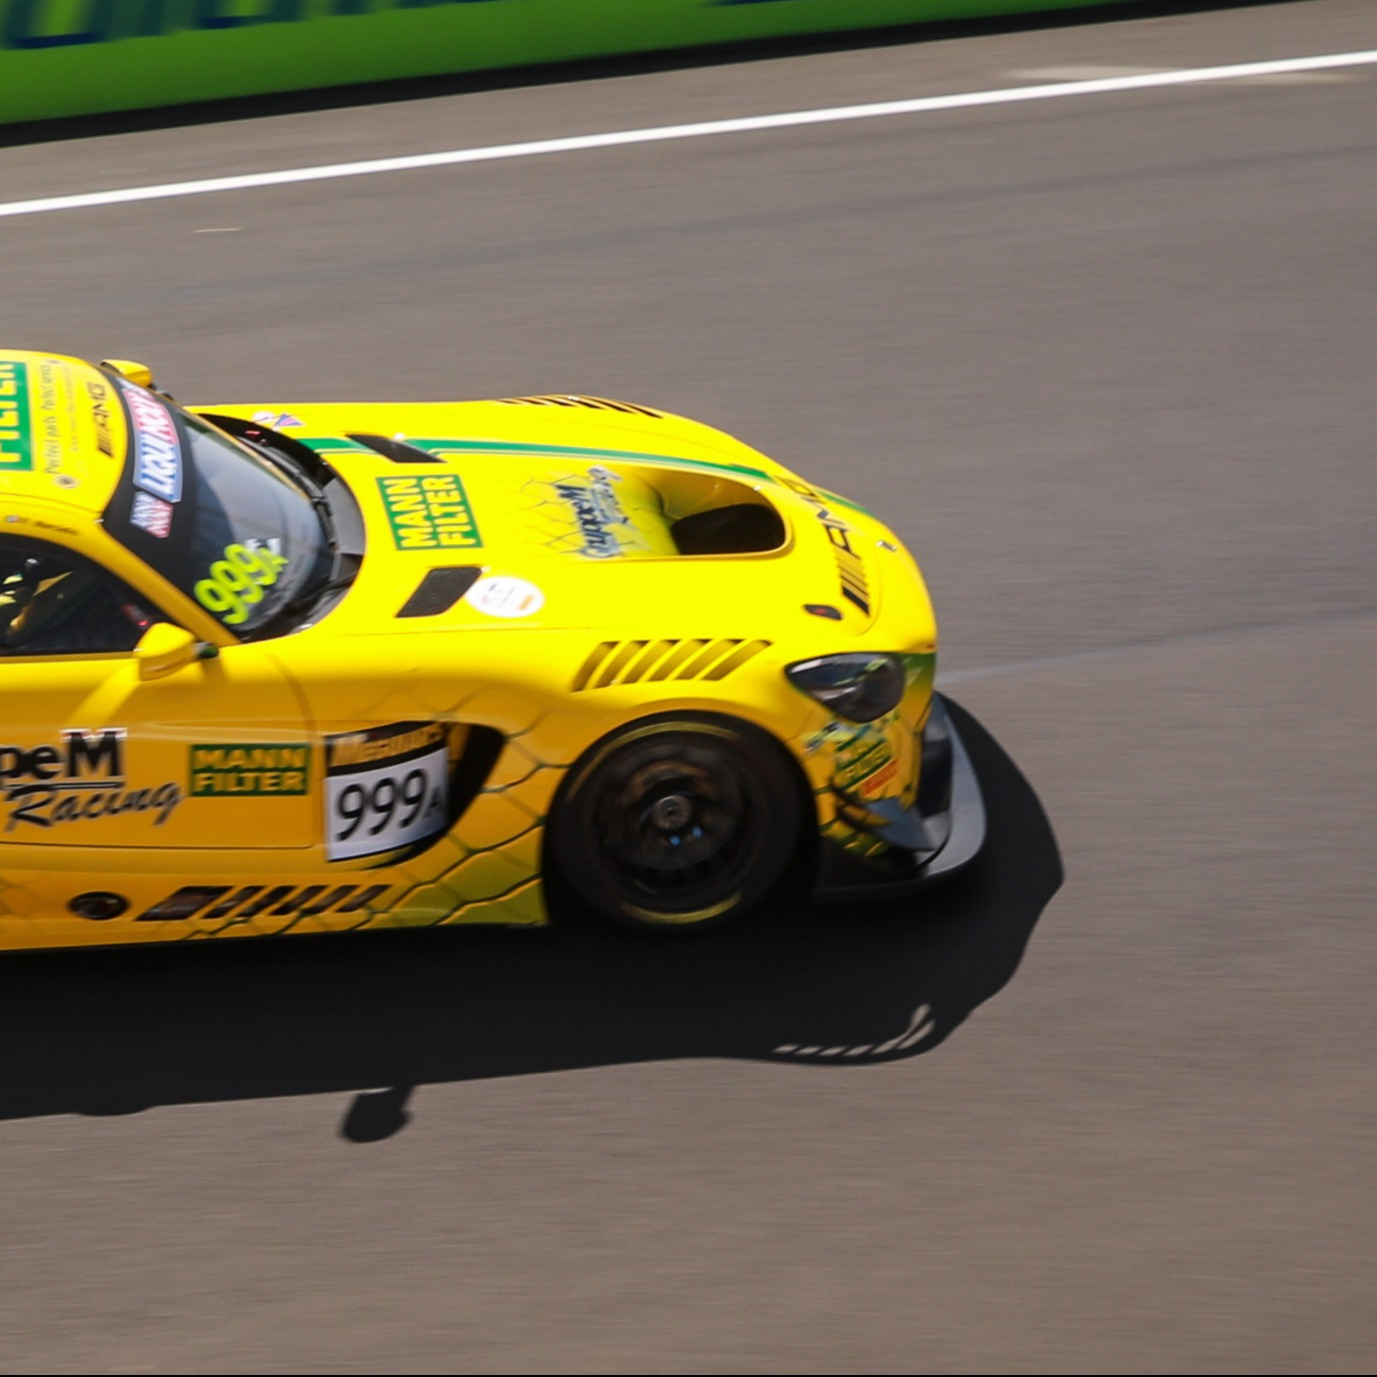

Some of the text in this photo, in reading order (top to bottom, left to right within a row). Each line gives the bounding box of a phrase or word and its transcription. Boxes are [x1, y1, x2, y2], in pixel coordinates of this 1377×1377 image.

[382, 478, 438, 547] MANN
[421, 475, 477, 546] FILTER
[193, 748, 306, 769] MANN
[193, 771, 306, 792] FILTER
[4, 782, 185, 832] Racing
